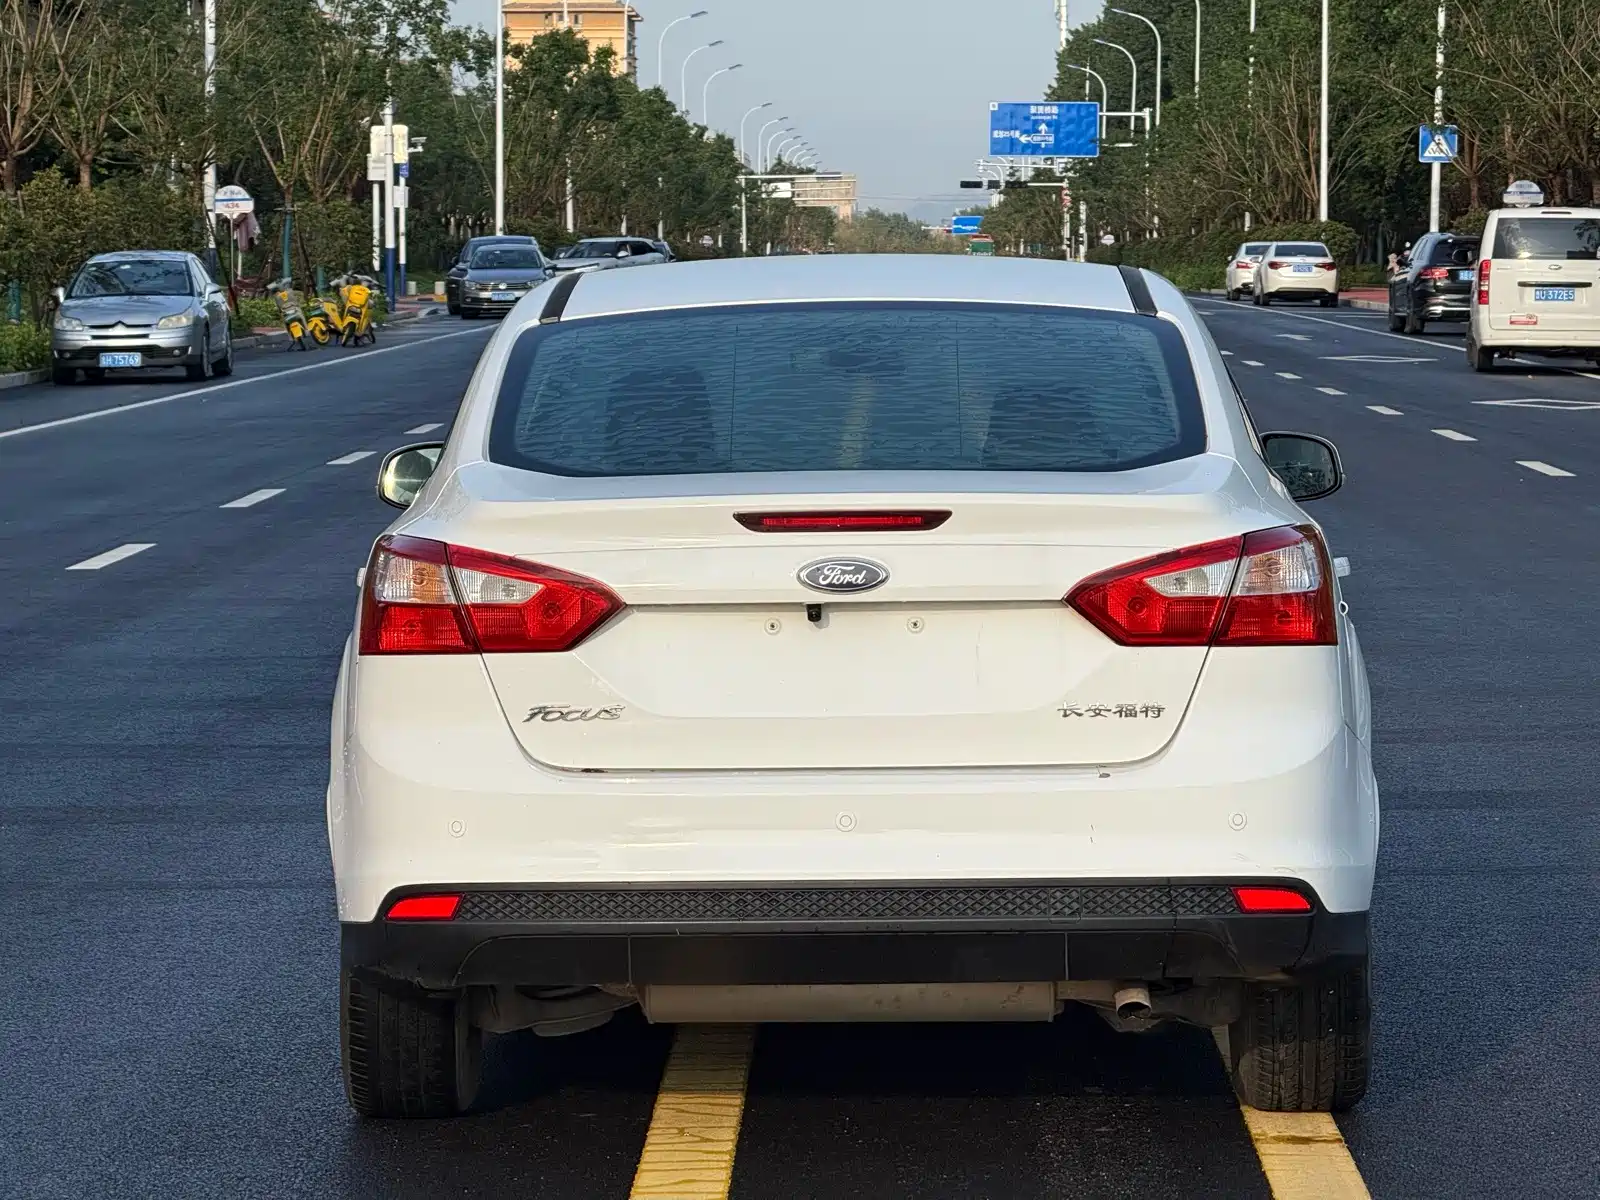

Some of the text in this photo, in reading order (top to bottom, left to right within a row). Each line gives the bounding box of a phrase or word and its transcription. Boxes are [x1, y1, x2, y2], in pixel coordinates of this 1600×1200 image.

[819, 565, 865, 585] Ford
[1057, 702, 1165, 718] 长安福特
